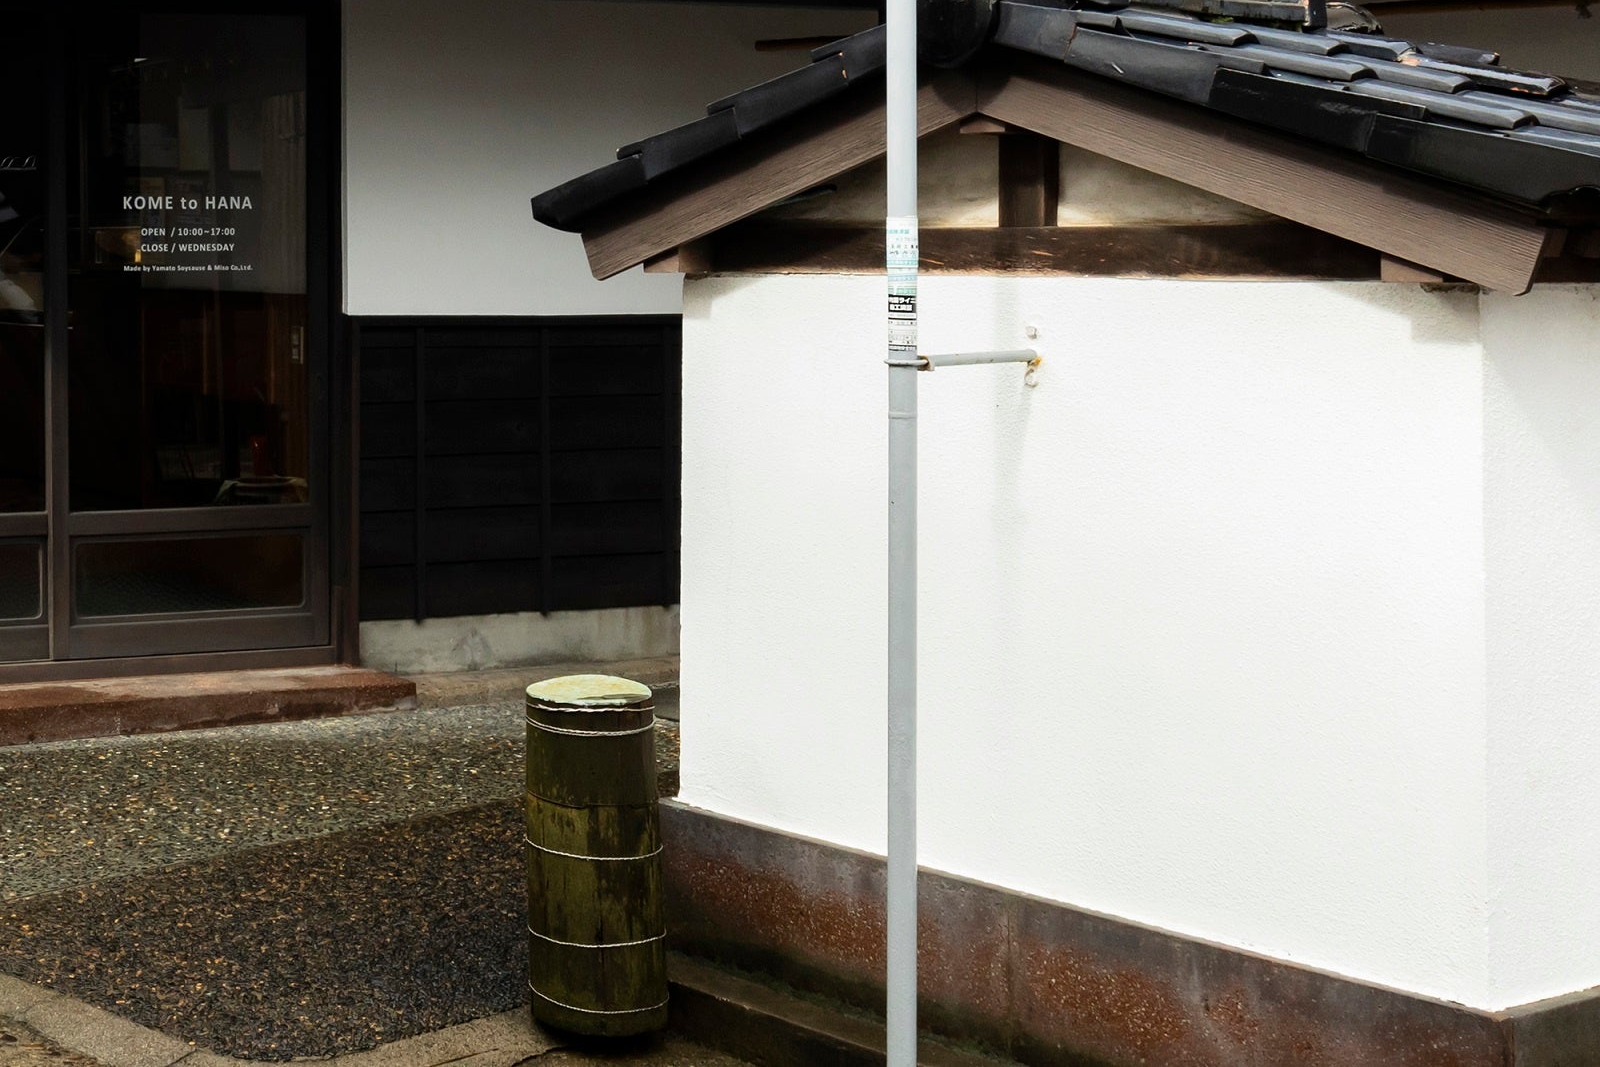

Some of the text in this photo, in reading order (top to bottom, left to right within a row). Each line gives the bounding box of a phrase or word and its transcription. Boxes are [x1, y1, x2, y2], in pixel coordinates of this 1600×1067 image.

[123, 196, 253, 210] KOME to HANA
[141, 228, 166, 236] OPEN
[170, 227, 176, 237] /
[141, 242, 235, 253] CLOSE / WEDNESDAY
[142, 265, 150, 273] by
